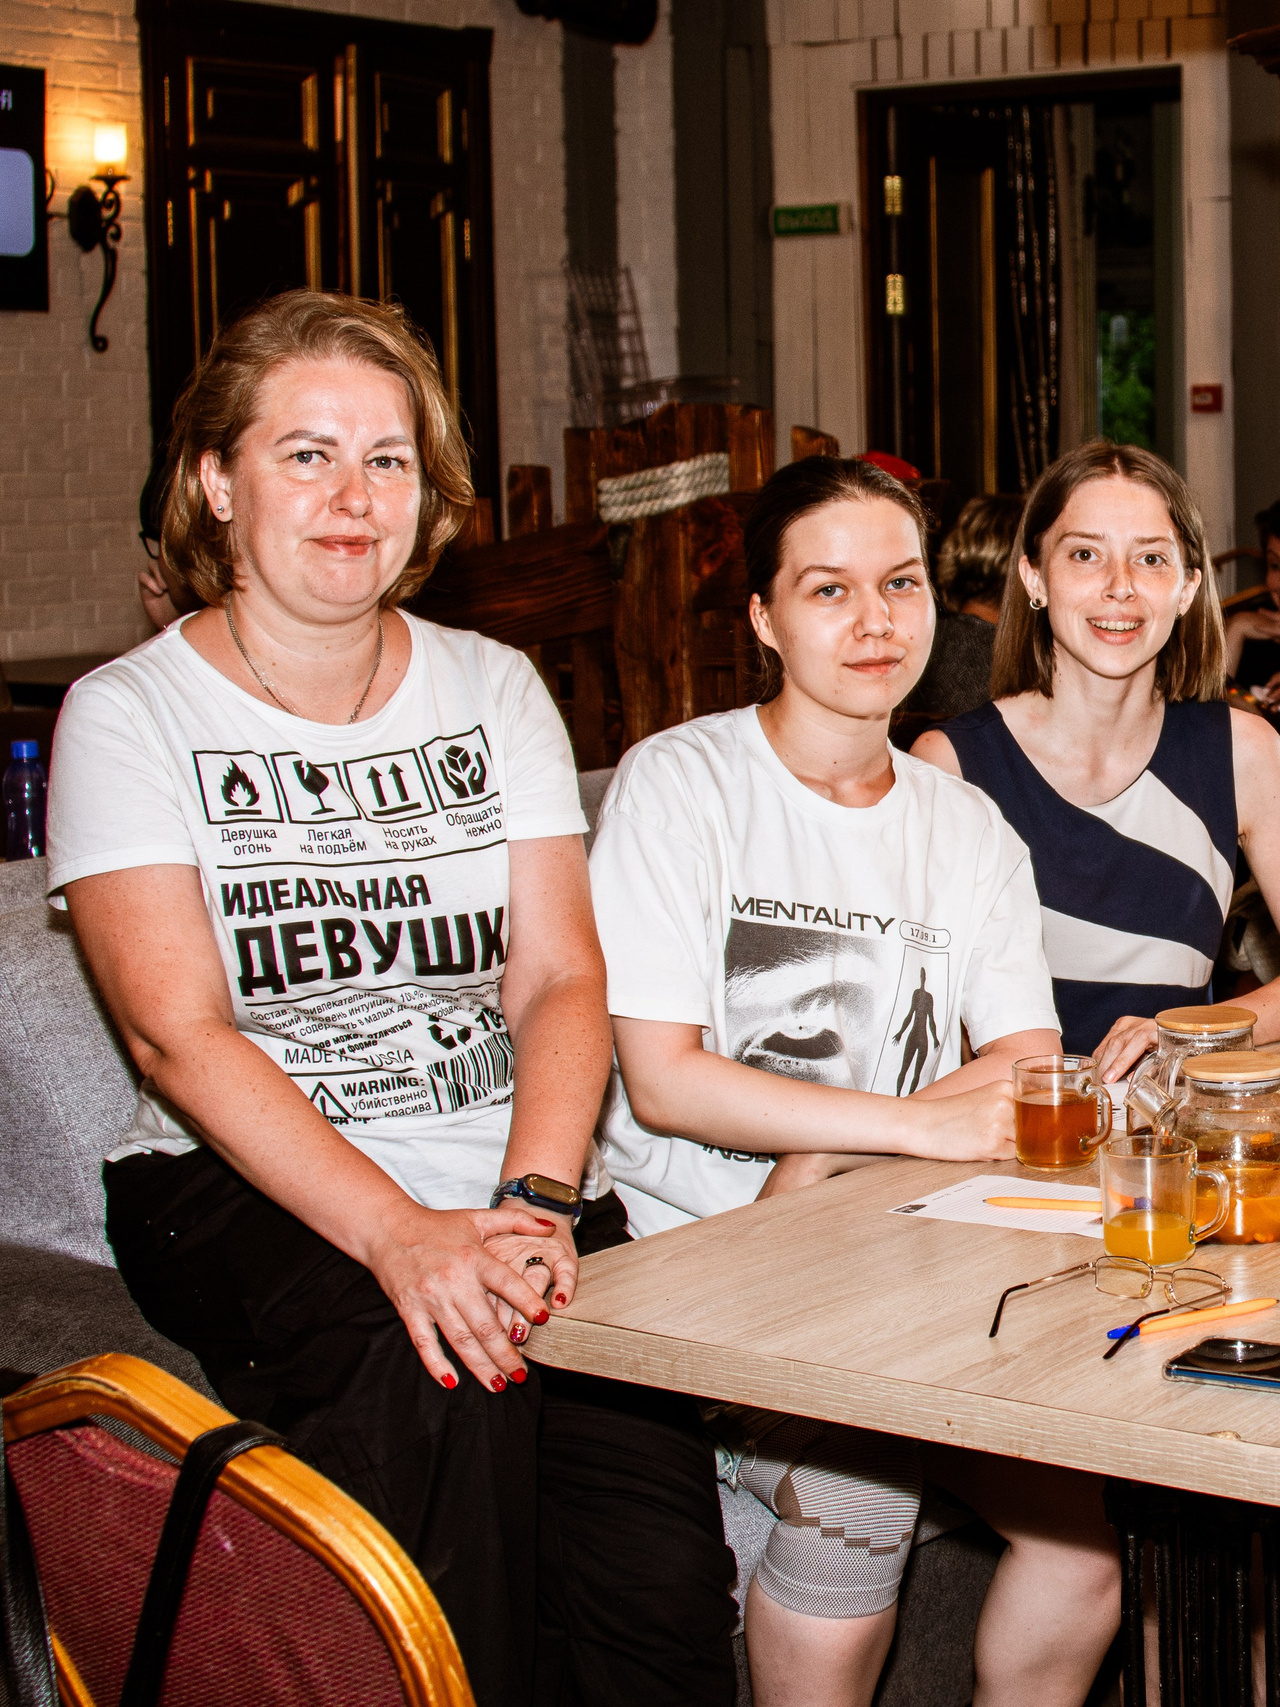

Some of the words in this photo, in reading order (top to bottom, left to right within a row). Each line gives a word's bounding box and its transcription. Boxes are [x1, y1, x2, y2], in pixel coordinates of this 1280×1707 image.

[221, 828, 278, 845] Девушка
[306, 827, 352, 843] Легкая
[383, 825, 428, 839] Носить
[466, 820, 503, 838] нежно
[233, 843, 272, 856] огонь
[299, 843, 314, 855] на
[317, 840, 367, 855] подъём
[384, 840, 399, 850] на
[401, 836, 437, 853] руках
[220, 874, 432, 919] ИДЕАЛЬНАЯ
[731, 893, 896, 935] MENTALITY
[250, 1008, 291, 1020] Состав:
[358, 1018, 365, 1026] в
[365, 1006, 395, 1023] малых
[366, 1019, 413, 1039] отличаться
[347, 1040, 378, 1054] форме
[284, 1047, 333, 1065] MADE
[340, 1075, 426, 1098] WARNING:
[350, 1089, 428, 1114] убийственно
[384, 1101, 432, 1118] красива
